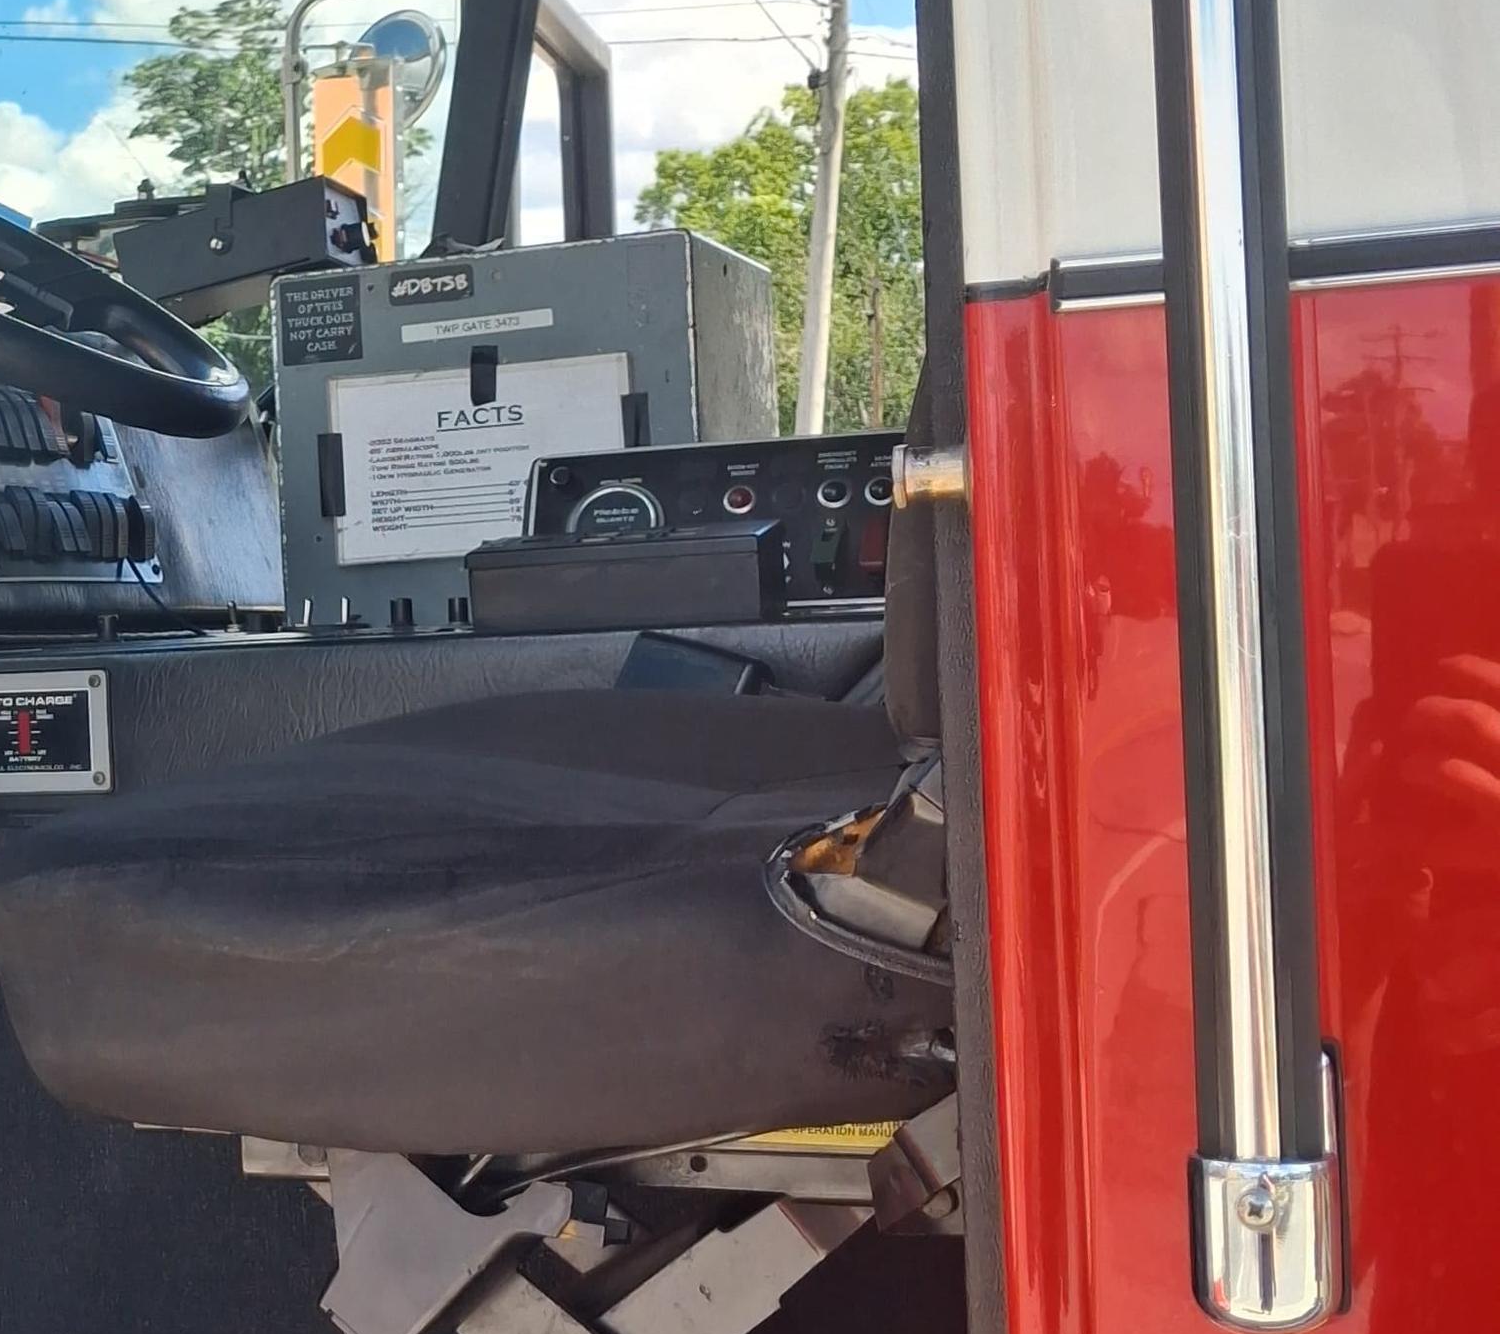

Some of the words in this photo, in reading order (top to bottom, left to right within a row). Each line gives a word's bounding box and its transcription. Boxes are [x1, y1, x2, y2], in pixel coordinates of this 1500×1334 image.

[285, 291, 309, 302] THE
[310, 286, 354, 300] DRIVER
[297, 303, 313, 314] OF
[315, 300, 343, 312] THIS
[287, 316, 325, 328] TRUCK
[325, 312, 354, 324] DOES
[461, 319, 493, 332] GATE
[289, 329, 313, 341] NOT
[316, 325, 354, 338] CARRY
[306, 340, 337, 352] CASH
[436, 405, 524, 428] FACTS
[15, 695, 73, 707] CHARGE
[858, 1125, 891, 1137] MANU
